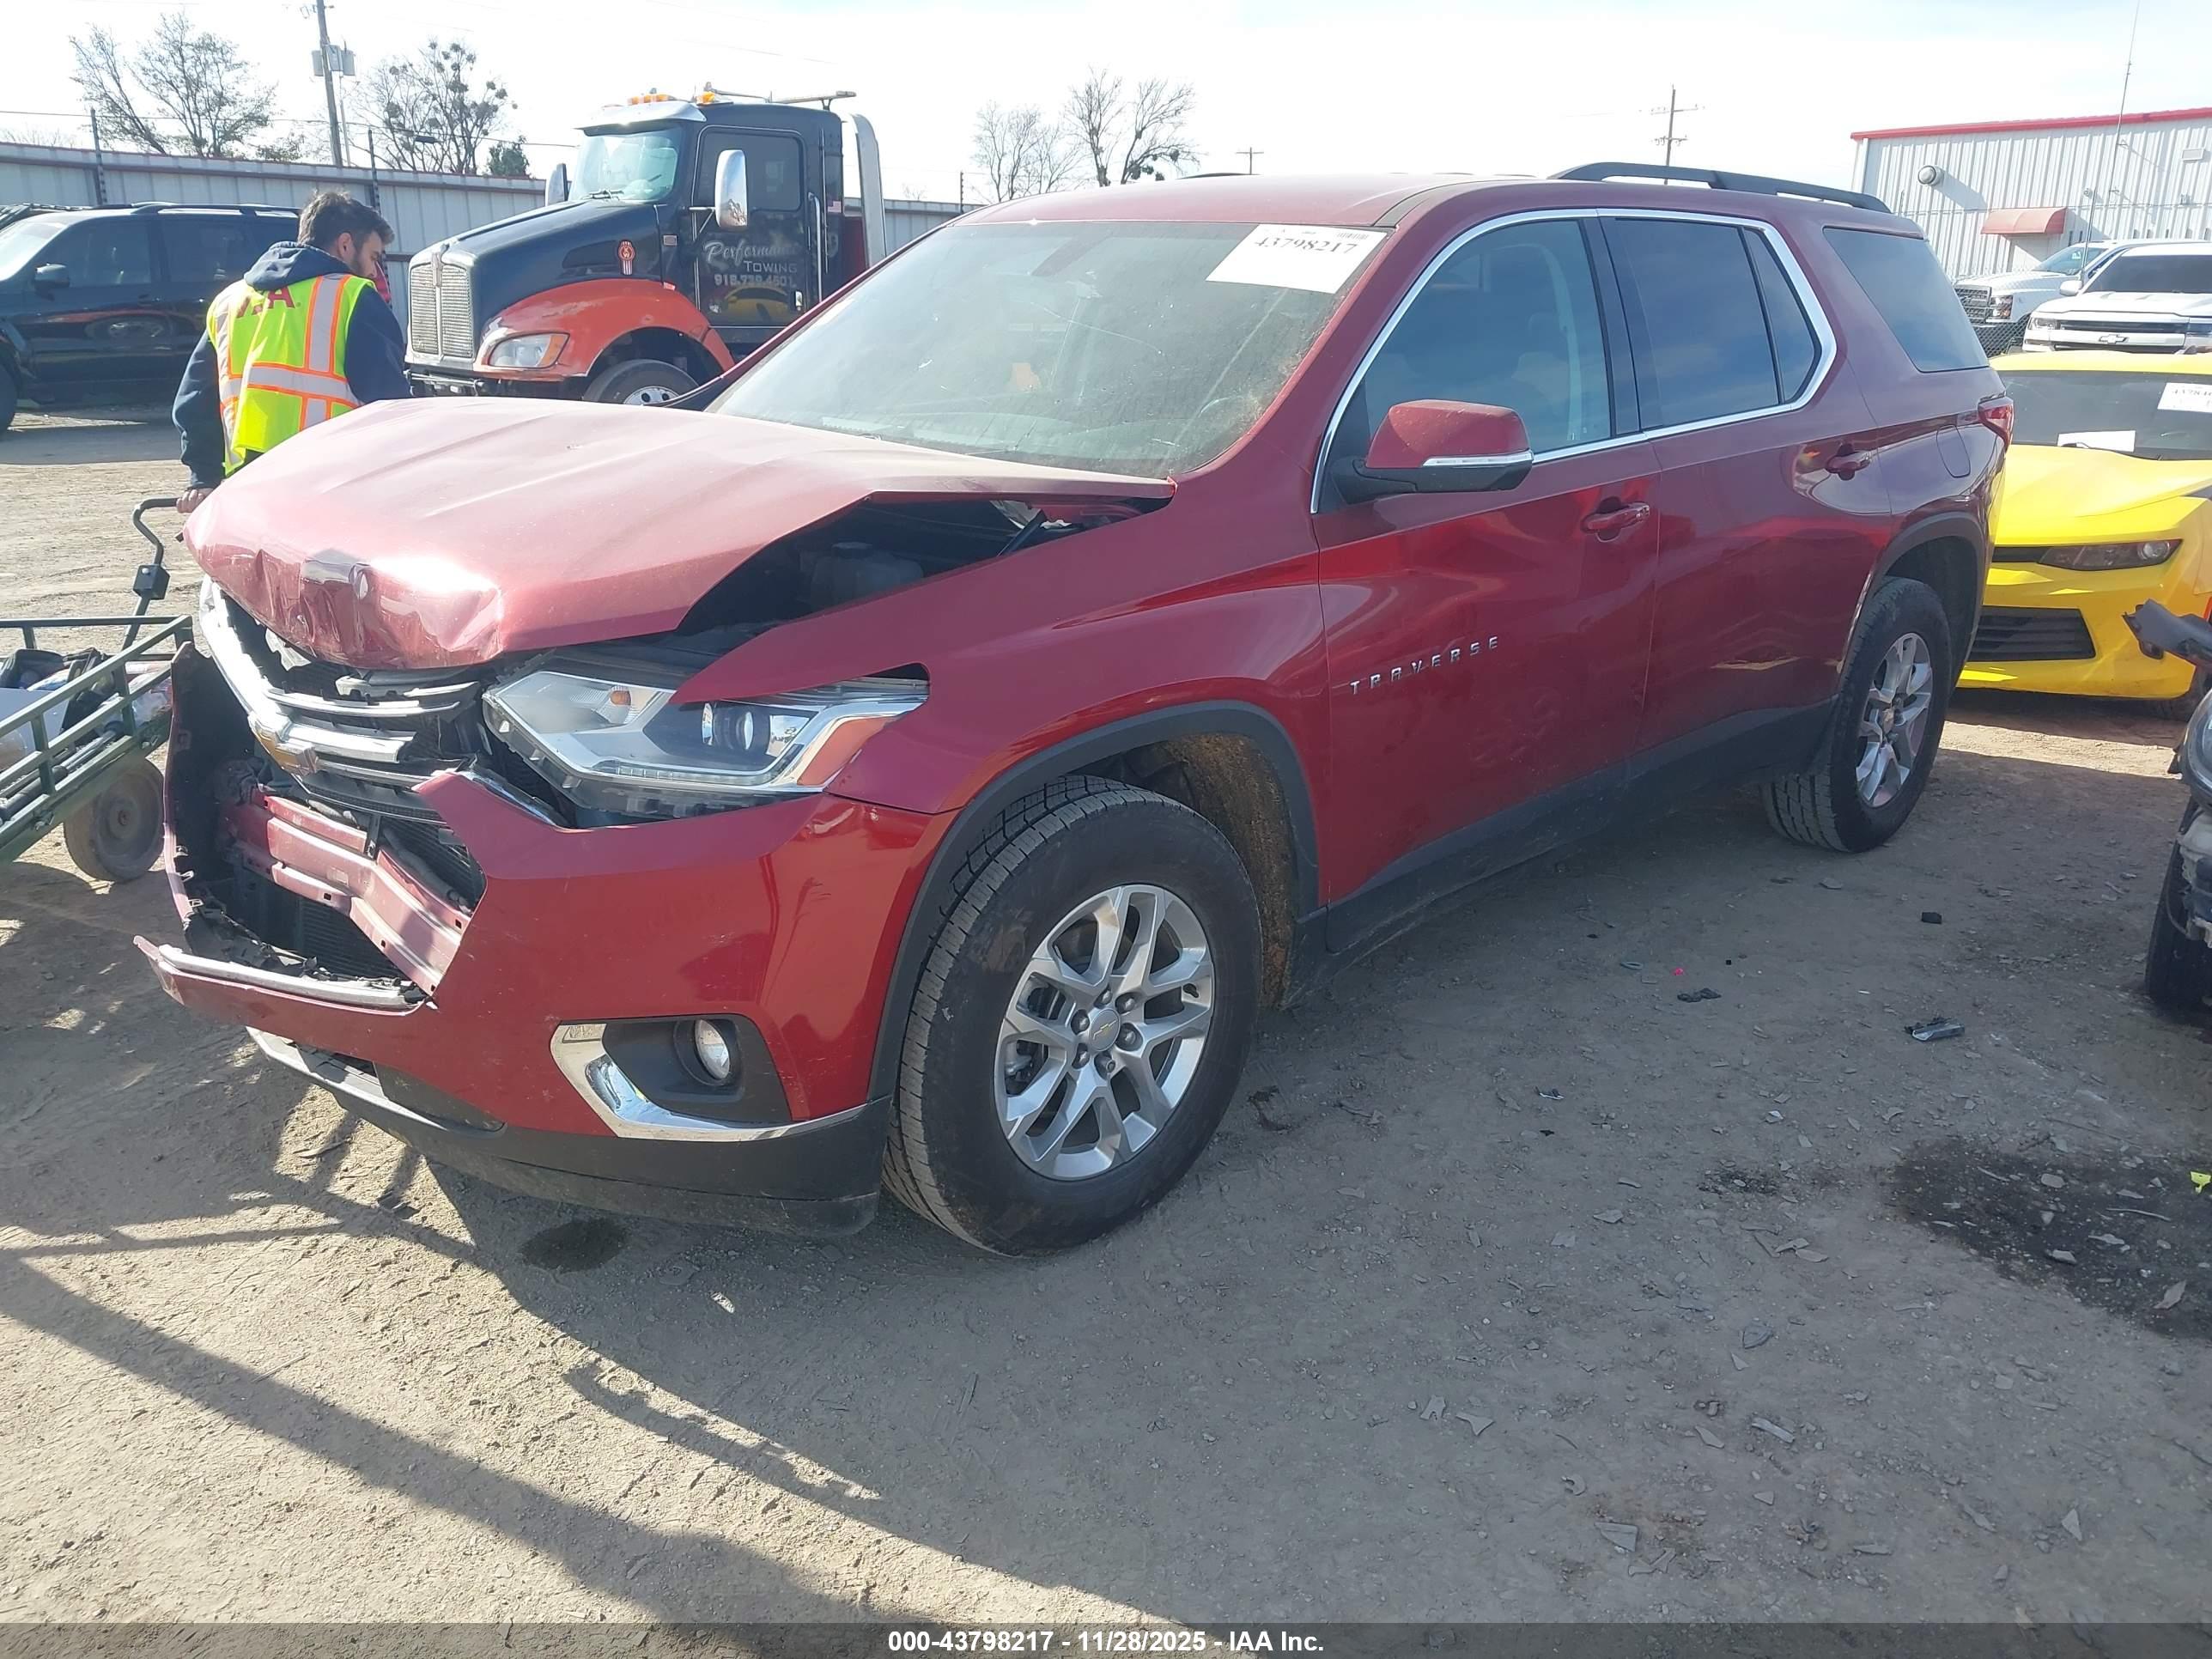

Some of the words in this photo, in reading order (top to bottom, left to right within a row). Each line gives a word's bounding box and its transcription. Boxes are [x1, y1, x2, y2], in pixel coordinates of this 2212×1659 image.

[704, 239, 799, 266] Performan
[1255, 237, 1358, 254] 43798217
[744, 260, 797, 274] TOWING
[1350, 636, 1498, 695] TRAVERSE
